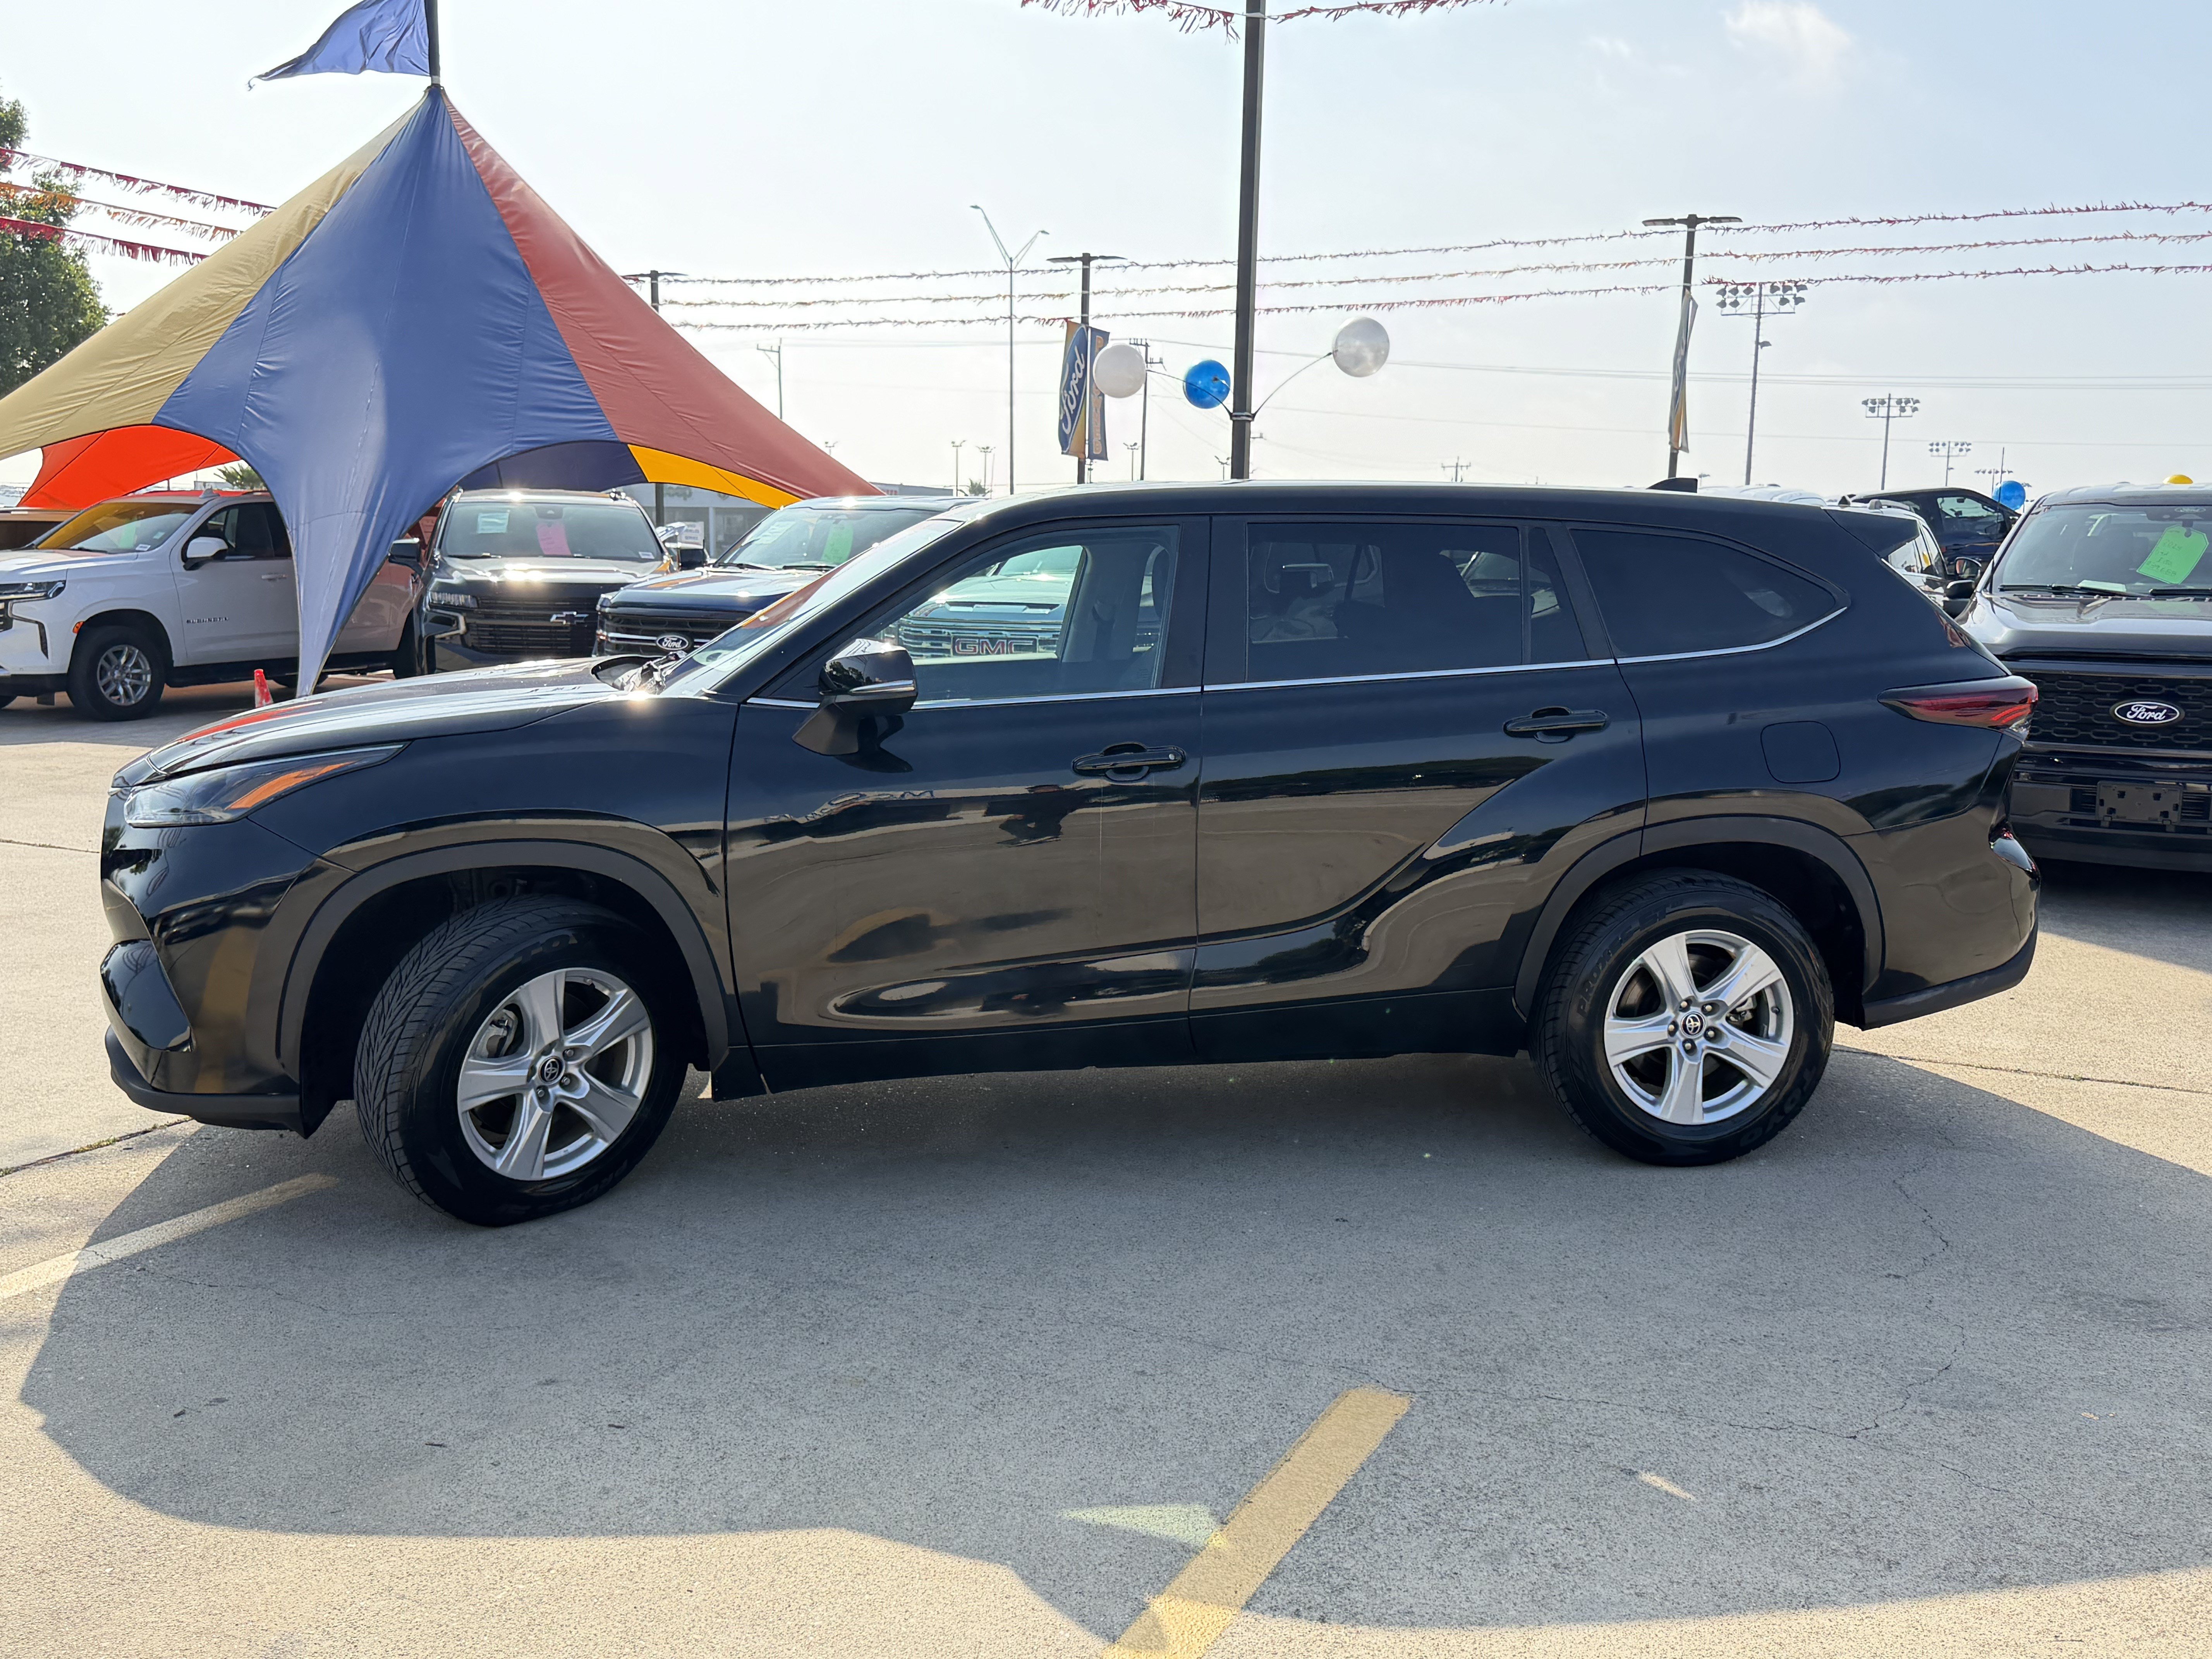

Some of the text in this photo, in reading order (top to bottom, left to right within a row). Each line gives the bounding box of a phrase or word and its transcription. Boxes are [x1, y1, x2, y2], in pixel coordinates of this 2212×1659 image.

[1060, 345, 1085, 435] Ford
[955, 638, 1034, 655] GMC
[2126, 704, 2167, 720] Ford
